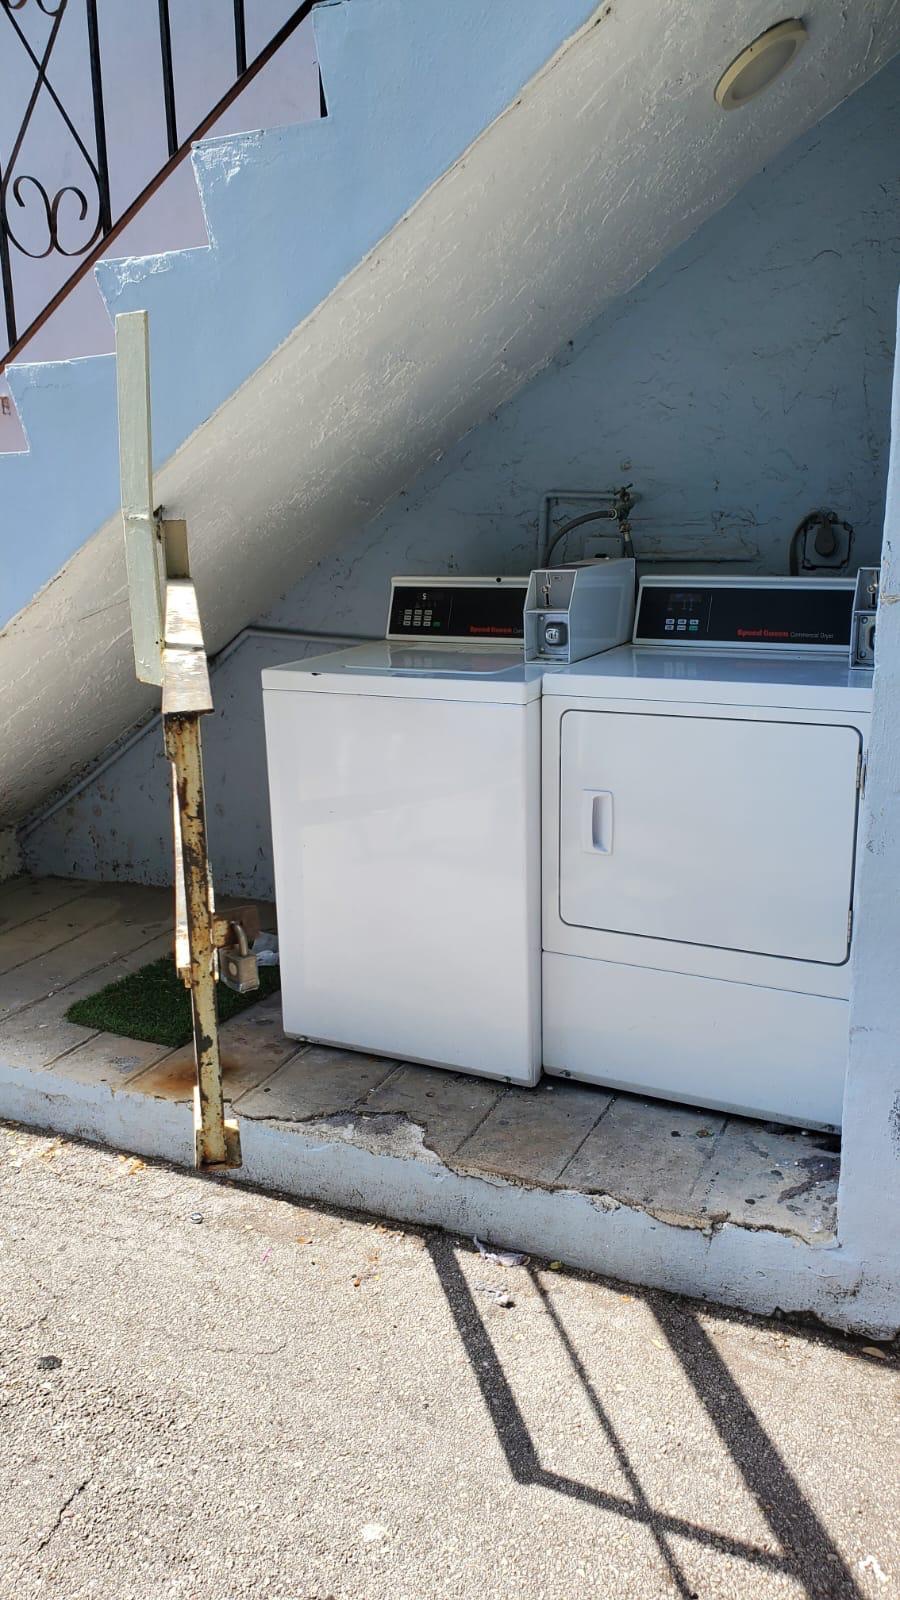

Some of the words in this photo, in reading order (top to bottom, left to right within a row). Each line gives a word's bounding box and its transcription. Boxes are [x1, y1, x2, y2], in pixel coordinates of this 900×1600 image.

[737, 628, 762, 638] Speed
[763, 628, 790, 638] Queen
[790, 631, 820, 640] Commercial
[820, 632, 833, 640] Dryer
